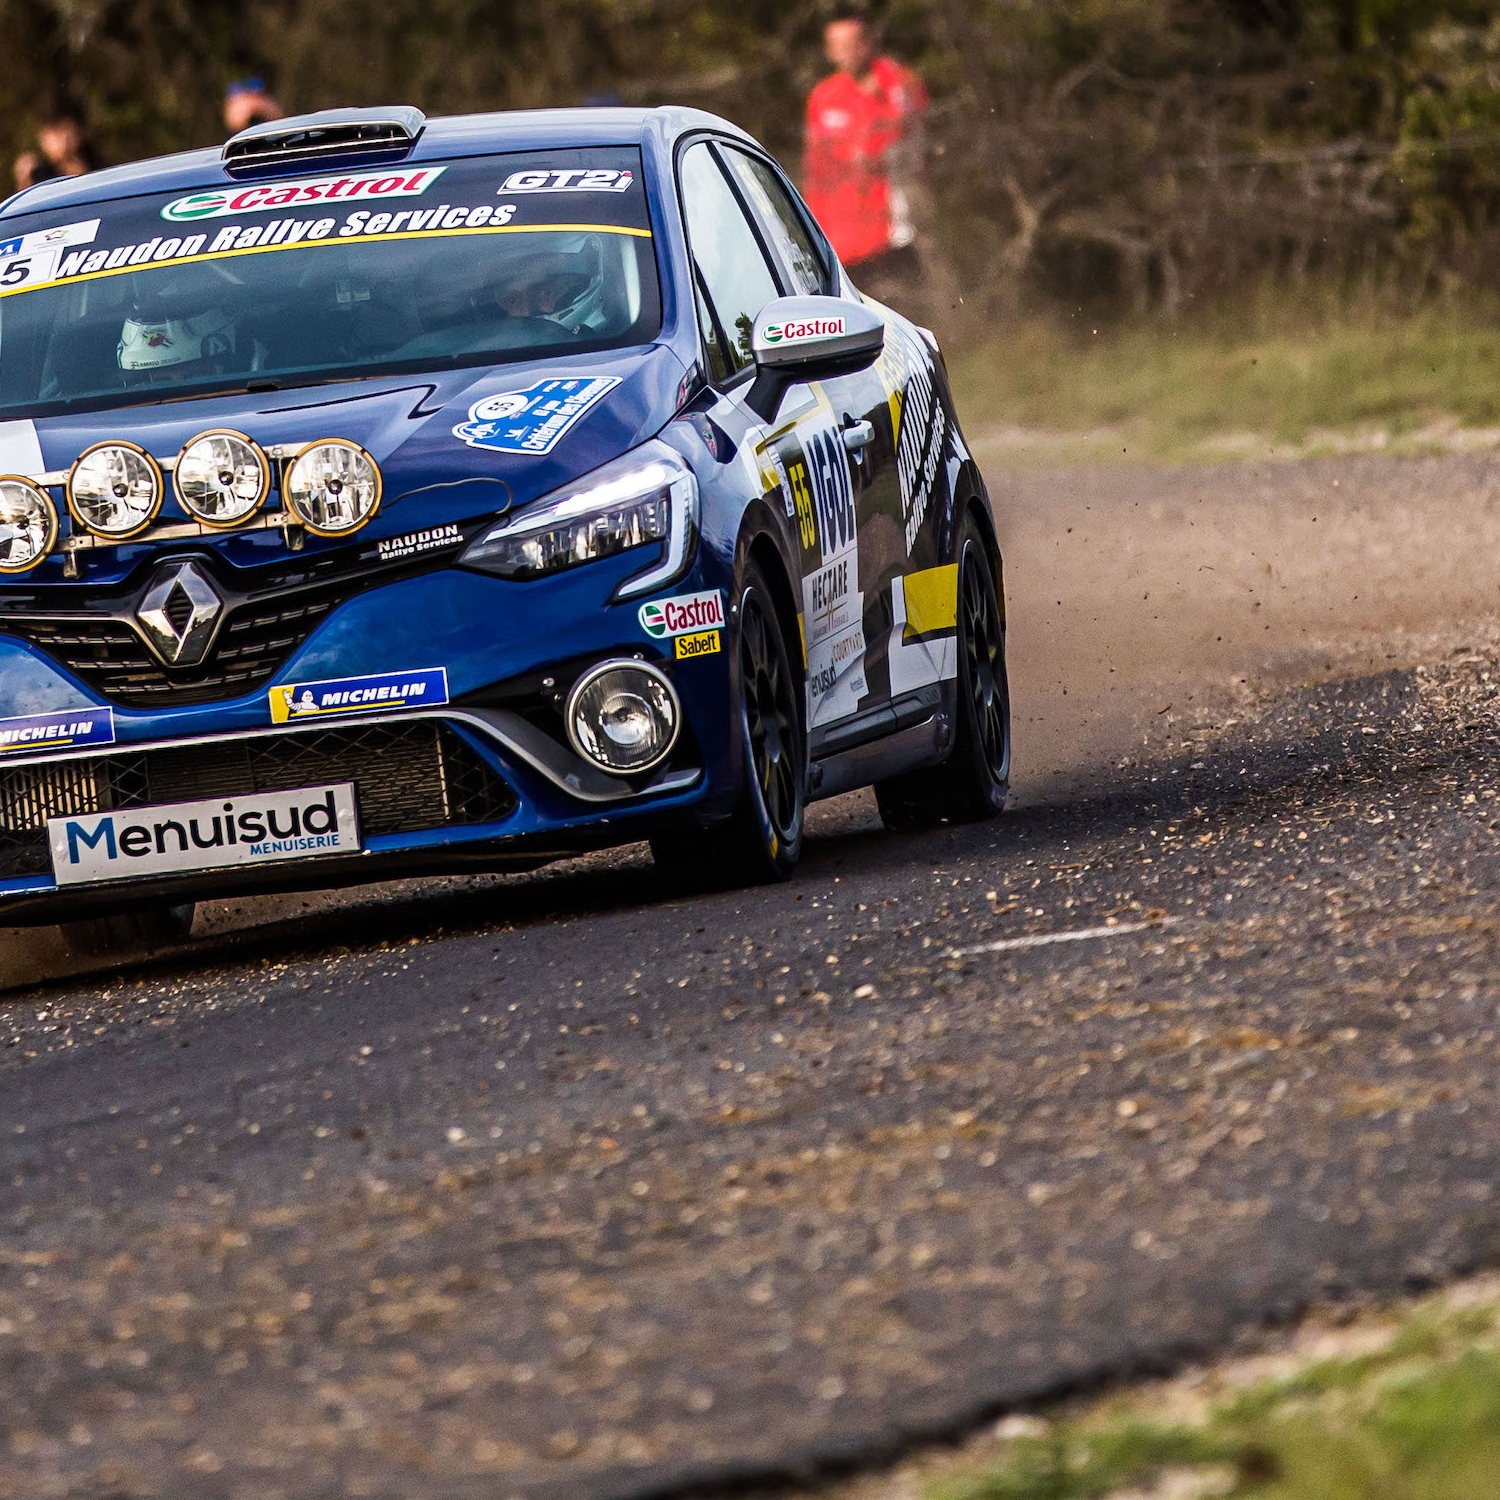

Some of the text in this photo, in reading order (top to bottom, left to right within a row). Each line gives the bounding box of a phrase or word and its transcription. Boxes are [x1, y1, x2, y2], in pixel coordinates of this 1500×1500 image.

[228, 171, 424, 210] Castrol
[506, 170, 633, 192] GT2i
[56, 204, 518, 279] Naudon Rallye Services
[784, 319, 845, 339] Castrol
[487, 401, 515, 412] 55
[897, 340, 933, 520] NAUDON
[905, 397, 946, 558] Rallye Services
[789, 463, 816, 550] 55
[378, 524, 458, 553] NAUDON
[381, 534, 464, 560] Rallye Services
[812, 560, 848, 613] HECTARE
[665, 594, 723, 631] Castrol
[678, 633, 717, 656] Sabelt
[321, 683, 427, 706] MICHELIN
[811, 657, 837, 698] enuisud
[66, 790, 340, 864] Menuisud
[250, 834, 341, 856] MENUISERIE
